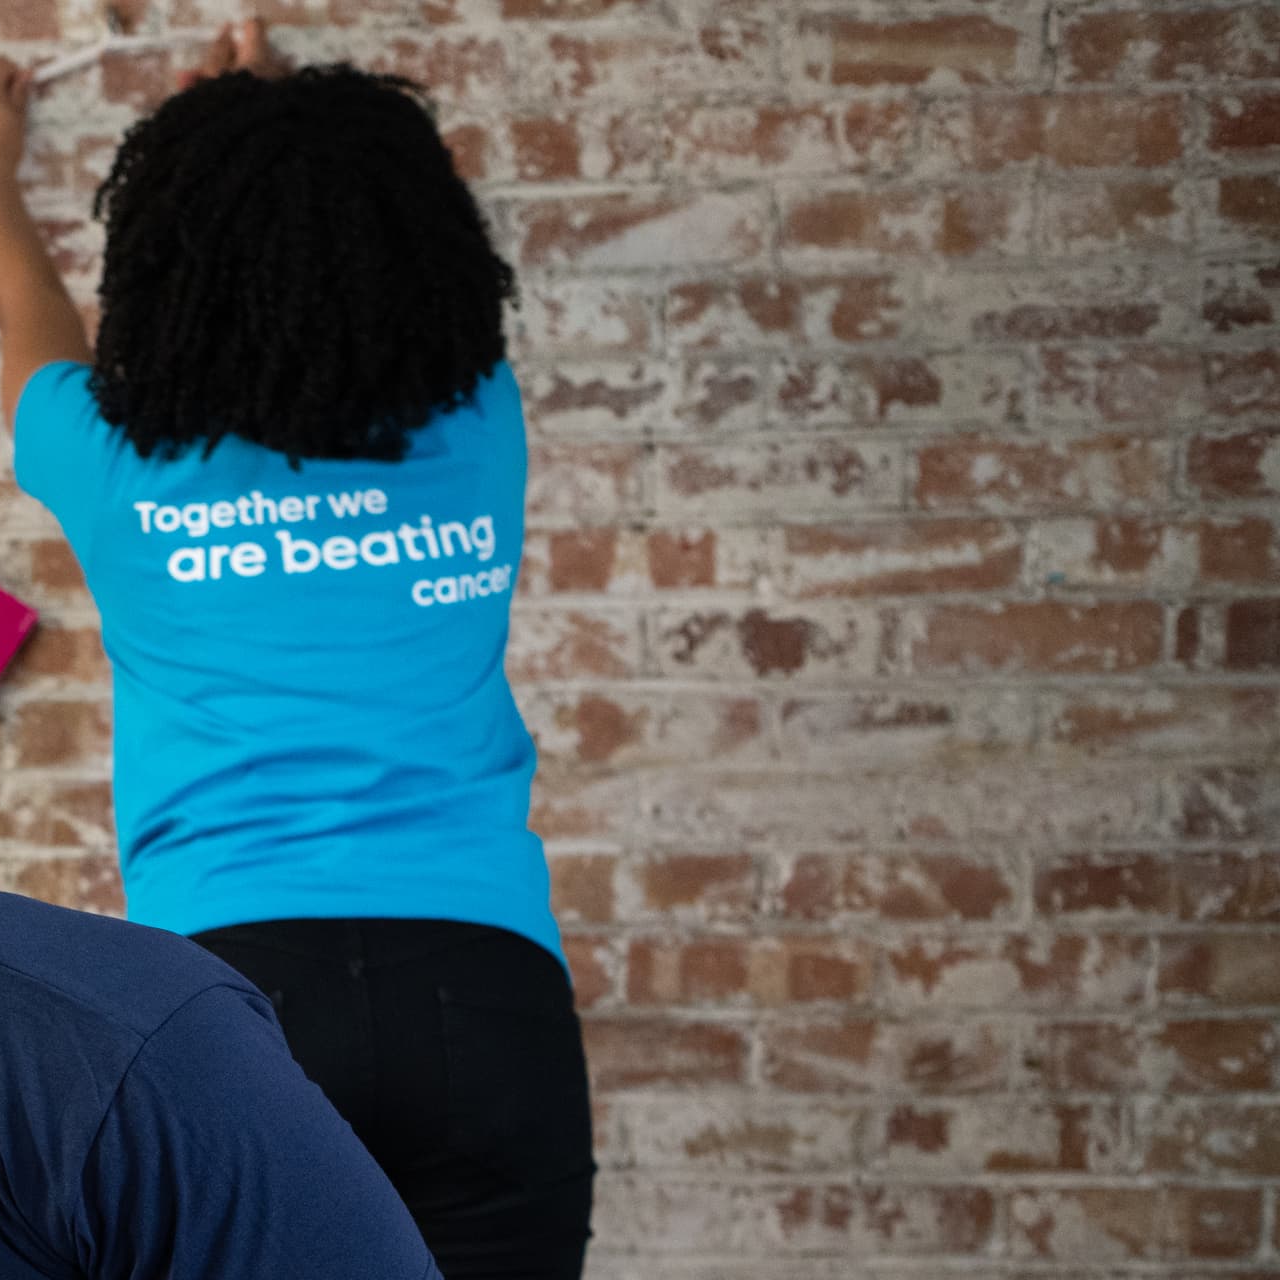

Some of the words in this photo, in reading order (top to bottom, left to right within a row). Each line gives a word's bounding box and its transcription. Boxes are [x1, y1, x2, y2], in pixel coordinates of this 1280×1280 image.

[134, 490, 320, 537] Together
[327, 488, 388, 519] we
[167, 541, 267, 582] are
[275, 515, 495, 576] beating
[411, 564, 512, 607] cancer
